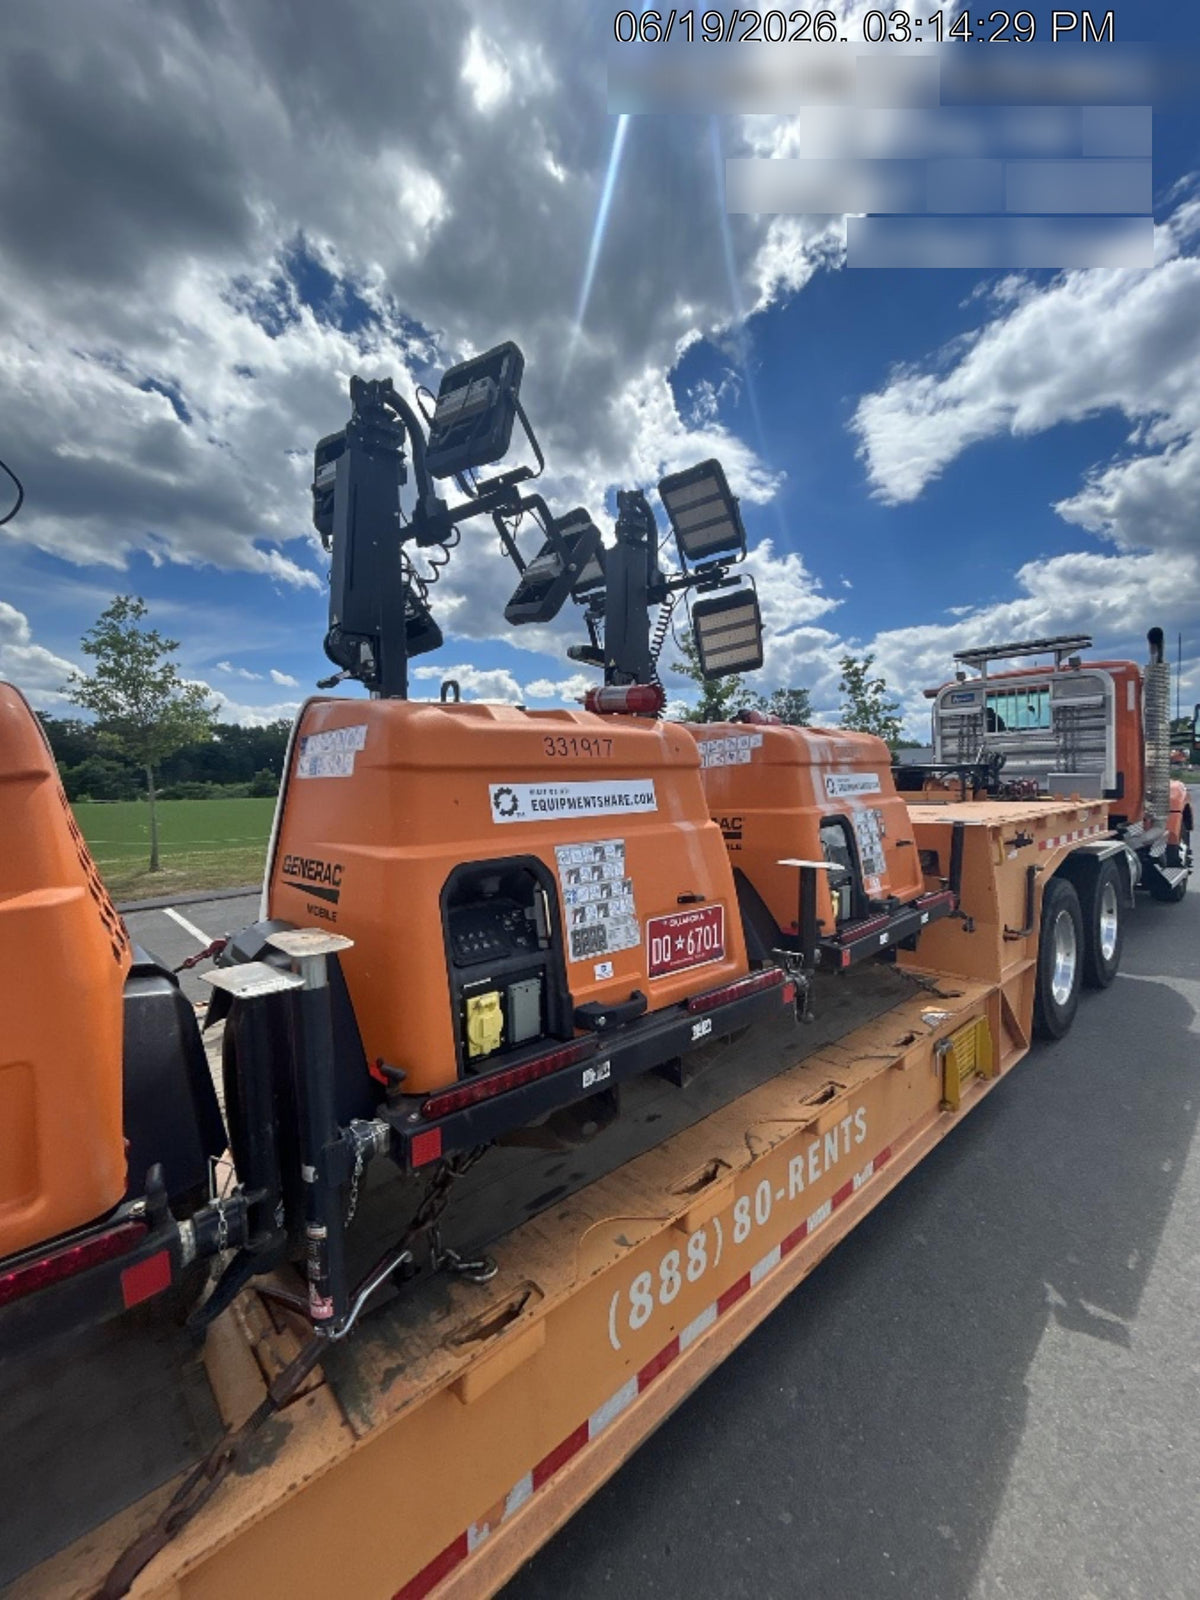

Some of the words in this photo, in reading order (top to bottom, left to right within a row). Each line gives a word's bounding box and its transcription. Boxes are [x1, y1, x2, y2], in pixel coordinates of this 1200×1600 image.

[543, 735, 614, 758] 331917
[531, 793, 656, 813] EQUIPMENTSHARE.COM
[282, 854, 342, 887] GENERAC
[307, 903, 338, 924] MOBILE
[687, 921, 720, 955] 6701
